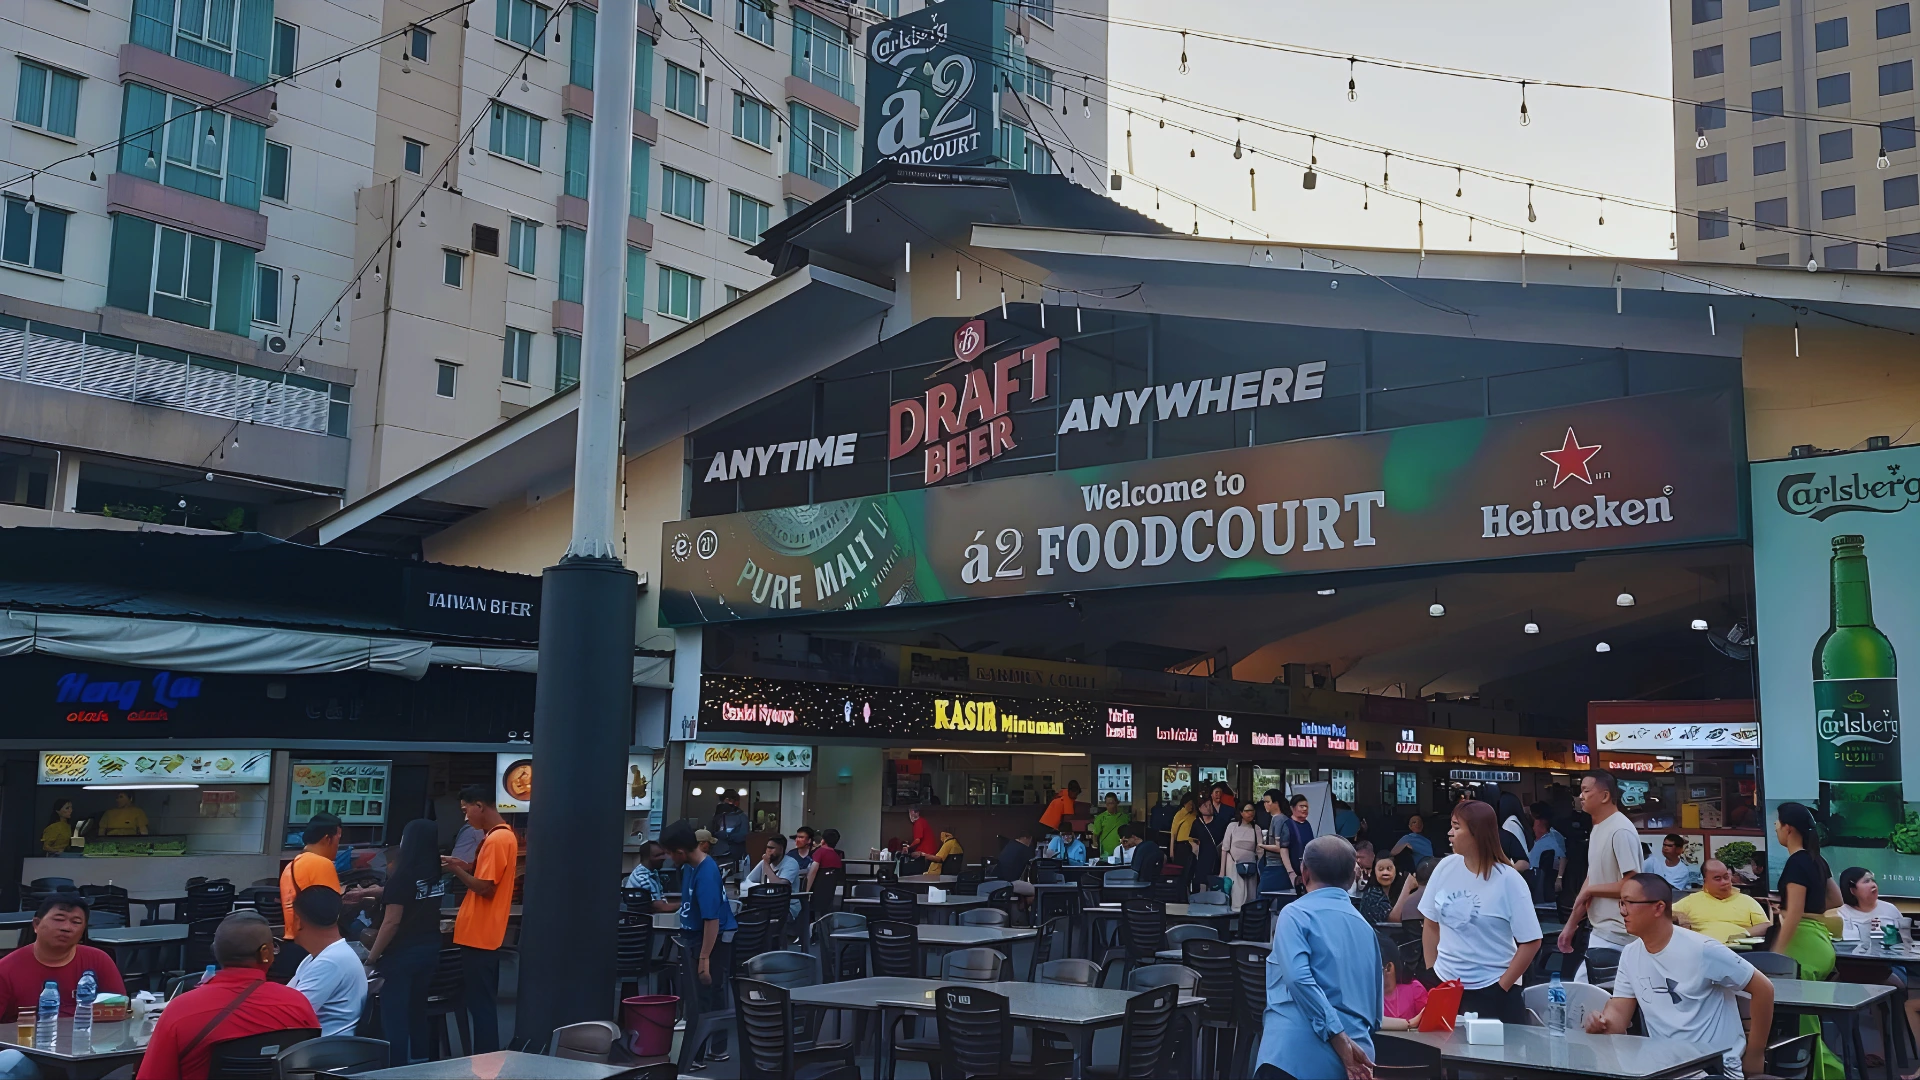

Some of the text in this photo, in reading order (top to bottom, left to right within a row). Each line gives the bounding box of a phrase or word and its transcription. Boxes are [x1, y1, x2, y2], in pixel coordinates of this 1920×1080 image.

[877, 132, 981, 164] ODCOURT
[889, 337, 1060, 460] DRAFT
[1058, 361, 1327, 434] ANYWHERE
[704, 433, 858, 483] ANYTIME
[924, 416, 1018, 485] BEER
[1080, 470, 1245, 511] Welcome to
[1036, 491, 1385, 576] FOODCOURT
[1481, 494, 1673, 538] Heineken
[736, 557, 802, 610] PURE
[814, 529, 874, 601] MALT
[427, 591, 532, 617] TAIWAN BEER
[934, 700, 1065, 735] KASIR Minuman
[1818, 709, 1898, 746] Carlsberg
